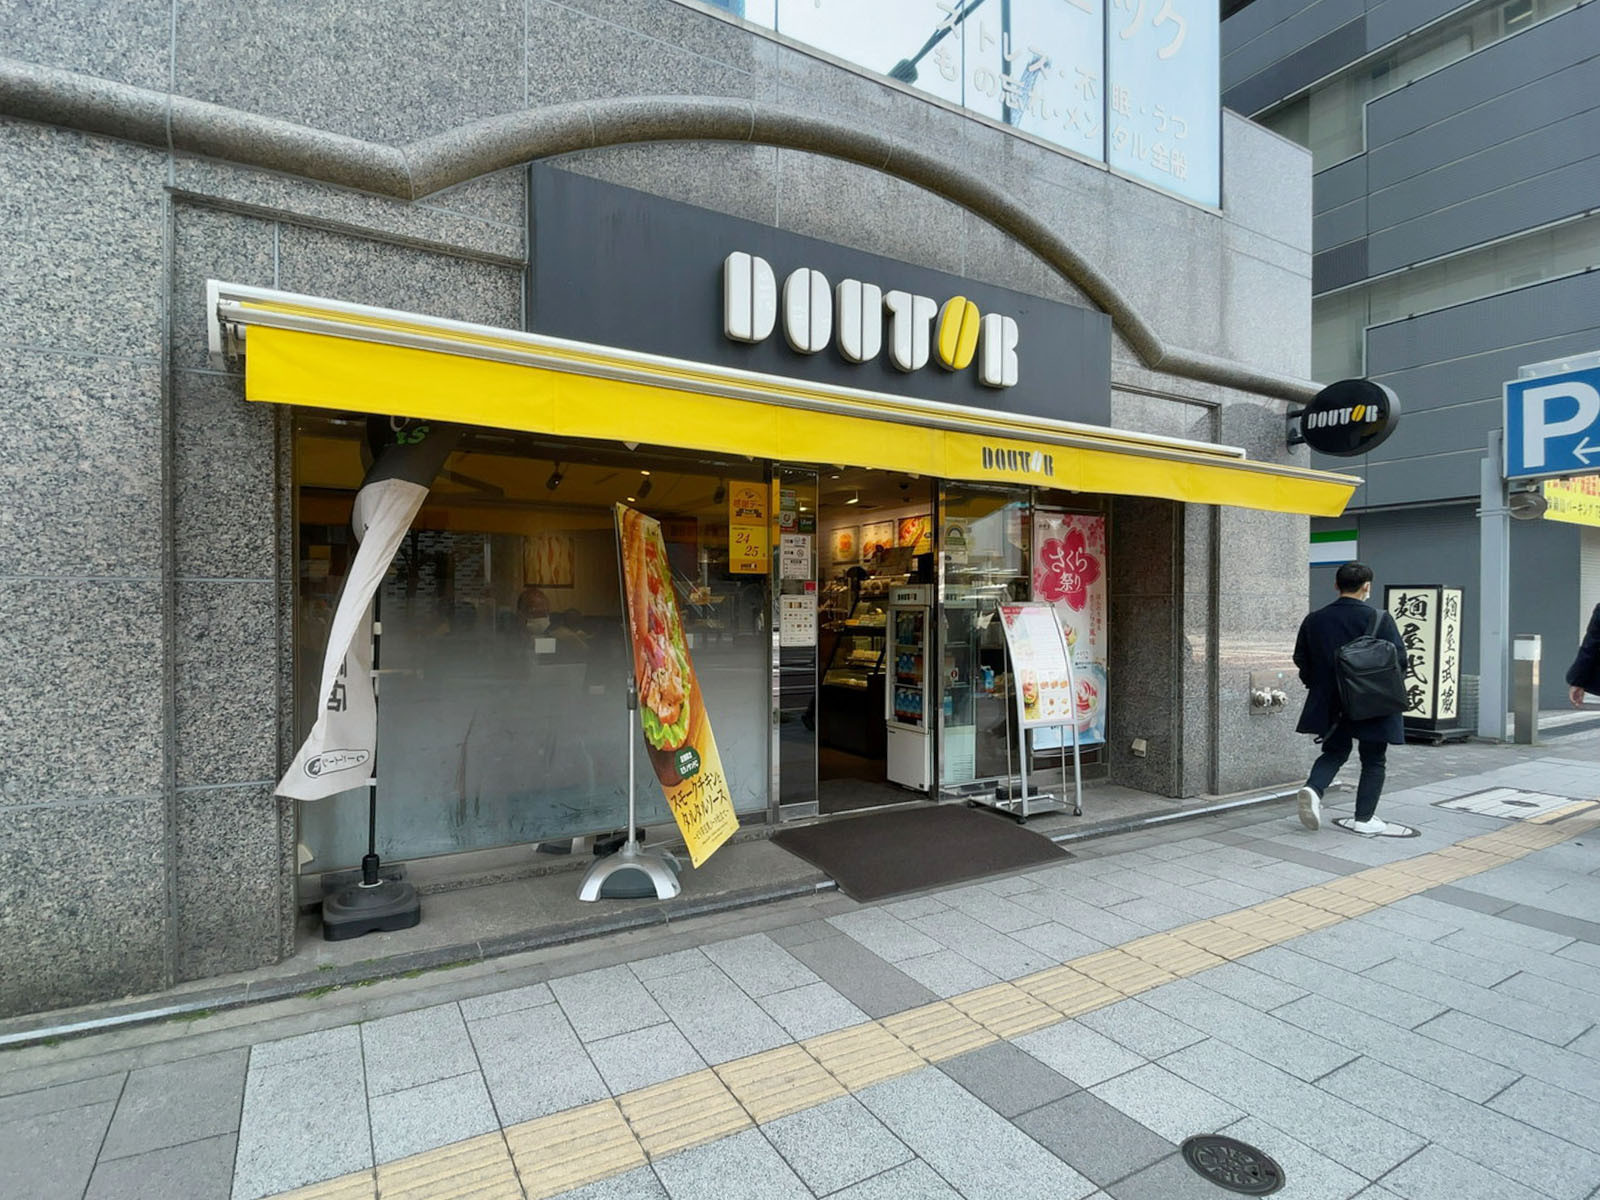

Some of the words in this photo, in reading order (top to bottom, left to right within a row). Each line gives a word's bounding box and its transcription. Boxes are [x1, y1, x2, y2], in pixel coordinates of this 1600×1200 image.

[724, 251, 1018, 388] DOUTOR
[1307, 404, 1379, 429] DOUTOR
[1523, 381, 1600, 468] P
[982, 446, 1054, 477] DOUTOR
[735, 532, 751, 545] 24
[743, 545, 760, 558] 25
[1049, 546, 1088, 573] さくら
[1057, 571, 1083, 592] 祭り
[681, 788, 728, 833] タルタルソース
